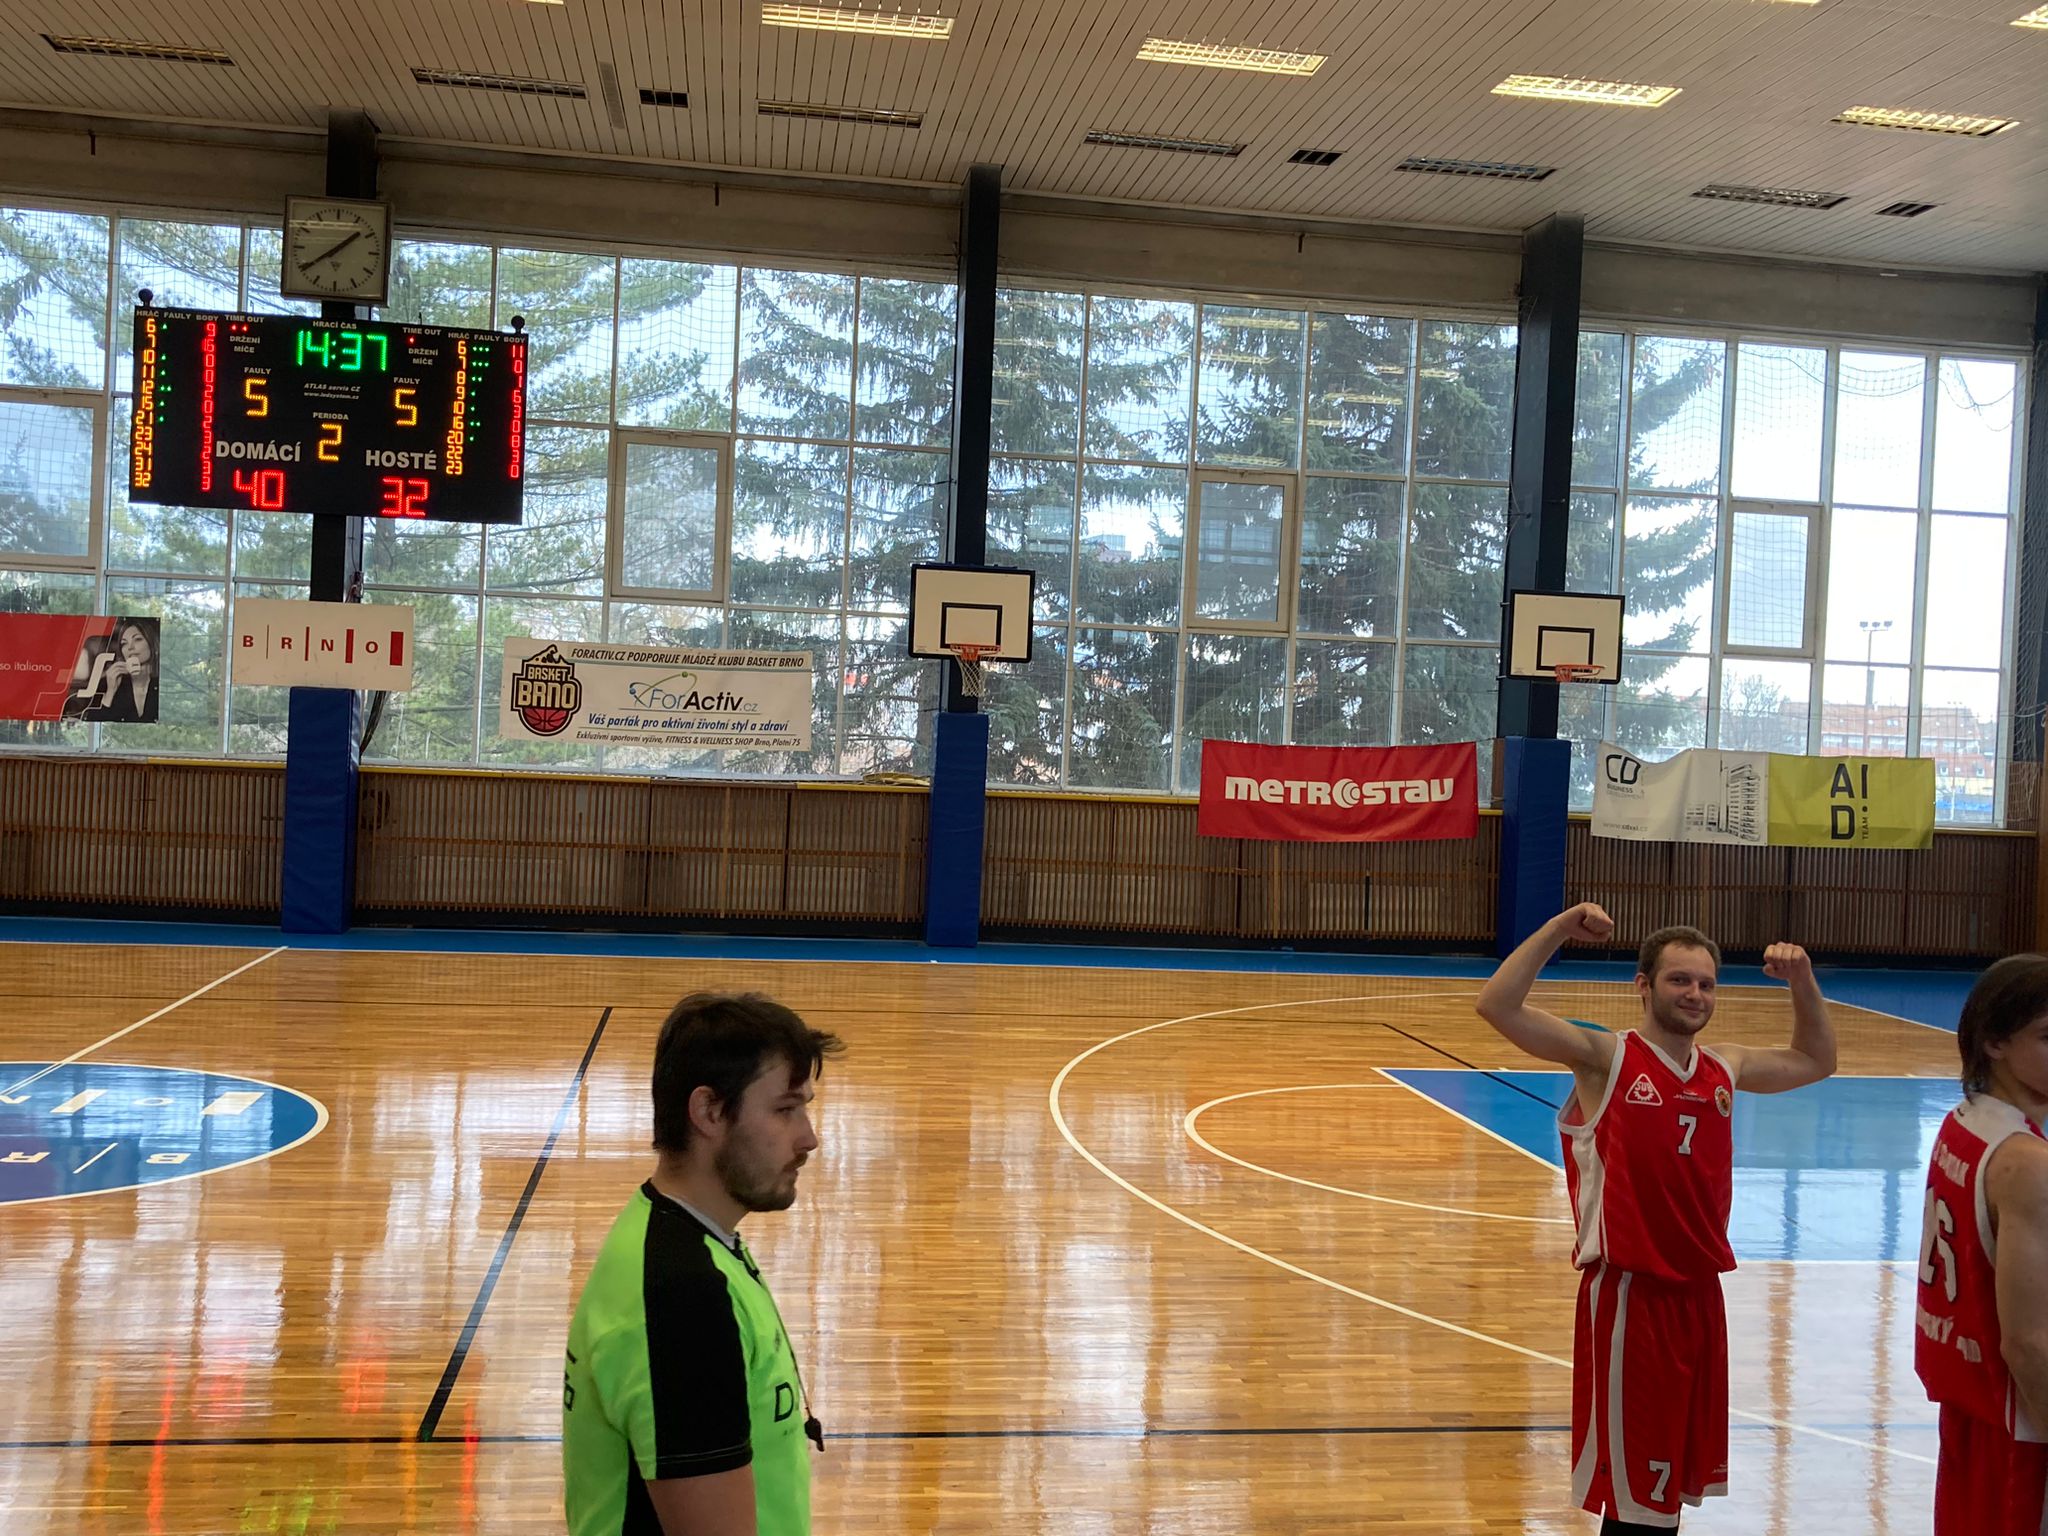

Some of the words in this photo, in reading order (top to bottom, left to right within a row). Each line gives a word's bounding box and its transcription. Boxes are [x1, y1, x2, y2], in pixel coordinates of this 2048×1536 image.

[164, 312, 191, 320] FAULY
[147, 318, 156, 332] 6
[206, 323, 216, 336] 9
[340, 322, 357, 330] ČAS
[424, 328, 442, 336] OUT
[147, 334, 156, 348] 7
[229, 335, 260, 344] DRŽENÍ
[474, 333, 500, 342] FAULY
[203, 338, 215, 352] 16
[233, 344, 255, 353] MÍČE
[298, 331, 387, 371] 14:37
[408, 347, 439, 356] DRŽENÍ
[458, 341, 466, 354] 6
[512, 345, 523, 358] 11
[143, 350, 155, 364] 10
[205, 354, 215, 367] 0
[413, 357, 433, 365] MÍČE
[458, 356, 466, 370] 7
[143, 365, 154, 378] 11
[244, 367, 272, 375] FAULY
[514, 360, 523, 373] 0
[205, 369, 214, 383] 0
[394, 377, 420, 385] FAULY
[457, 371, 466, 385] 8
[142, 380, 154, 394] 12
[204, 385, 213, 398] 2
[456, 386, 465, 399] 9
[142, 395, 153, 410] 15
[245, 378, 268, 416] 5
[513, 390, 521, 403] 6
[204, 400, 213, 413] 0
[395, 388, 417, 426] 5
[453, 401, 464, 415] 10
[513, 405, 521, 418] 3
[136, 410, 153, 425] 21
[203, 415, 212, 428] 2
[313, 412, 349, 420] PERIODA
[452, 416, 464, 430] 16
[135, 426, 153, 440] 23
[512, 420, 520, 433] 0
[203, 431, 212, 444] 3
[319, 424, 342, 461] 2
[447, 430, 464, 445] 20
[511, 435, 520, 448] 8
[134, 441, 151, 455] 24
[202, 447, 211, 459] 2
[216, 440, 301, 462] DOMÁCÍ
[446, 445, 463, 459] 22
[366, 450, 437, 470] HOSTÉ
[512, 450, 519, 463] 3
[135, 457, 151, 471] 31
[202, 461, 211, 474] 3
[446, 460, 463, 475] 23
[510, 464, 519, 478] 0
[135, 472, 151, 487] 32
[202, 476, 210, 490] 3
[235, 469, 284, 508] 40
[382, 477, 429, 516] 32
[571, 648, 626, 660] FORACTIV.CZ
[627, 651, 681, 663] PODPORUJE
[681, 653, 716, 666] MLÁDEŽ
[717, 656, 745, 666] KLUBU
[747, 657, 778, 667] BASKET
[779, 657, 804, 667] BRNO
[527, 666, 568, 681] BASKET
[517, 680, 575, 709] BRNO
[588, 713, 605, 724] Váš
[607, 714, 640, 728] parťák
[641, 718, 659, 729] pro
[661, 717, 696, 730] aktivní
[697, 718, 729, 731] životní
[731, 719, 749, 733] styl
[750, 722, 756, 731] a
[759, 720, 789, 732] zdraví
[665, 736, 692, 744] FITNESS
[699, 737, 733, 745] WELLNESS
[734, 738, 753, 746] SHOP
[1678, 1114, 1697, 1155] 7
[1649, 1460, 1671, 1502] 7
